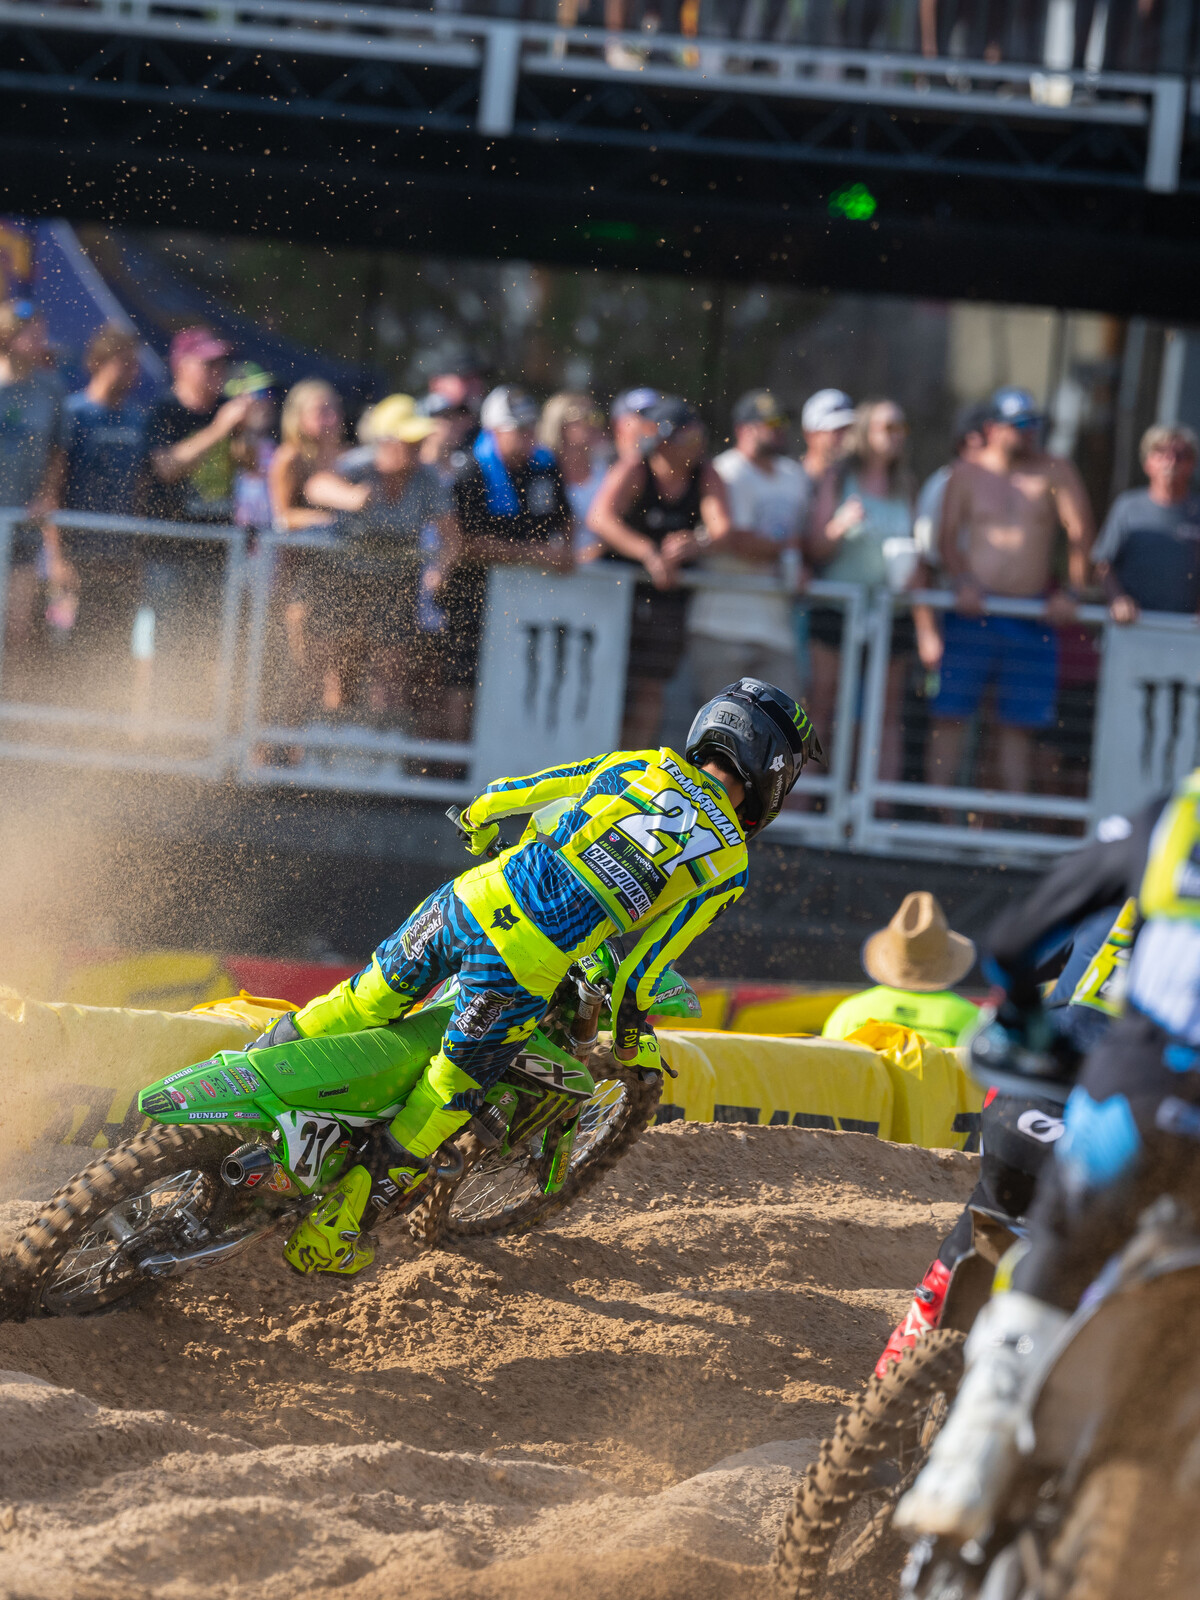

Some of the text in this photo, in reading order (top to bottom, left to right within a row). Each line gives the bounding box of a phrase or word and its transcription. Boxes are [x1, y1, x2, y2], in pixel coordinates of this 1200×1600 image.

[715, 709, 748, 731] ENZO
[658, 756, 744, 849] TEMMERMAN
[611, 786, 725, 881] 21
[598, 839, 623, 861] AMATEUR
[620, 858, 645, 883] NATIONAL
[587, 846, 651, 918] CHAMPIONSHI
[390, 972, 421, 993] FOX
[623, 1027, 639, 1049] FOX
[638, 1041, 658, 1055] FO
[163, 1067, 195, 1087] DUNLOP
[318, 1086, 350, 1099] Kawasaki
[188, 1111, 229, 1120] DUNLOP
[293, 1120, 339, 1178] 21
[378, 1178, 400, 1198] FOX
